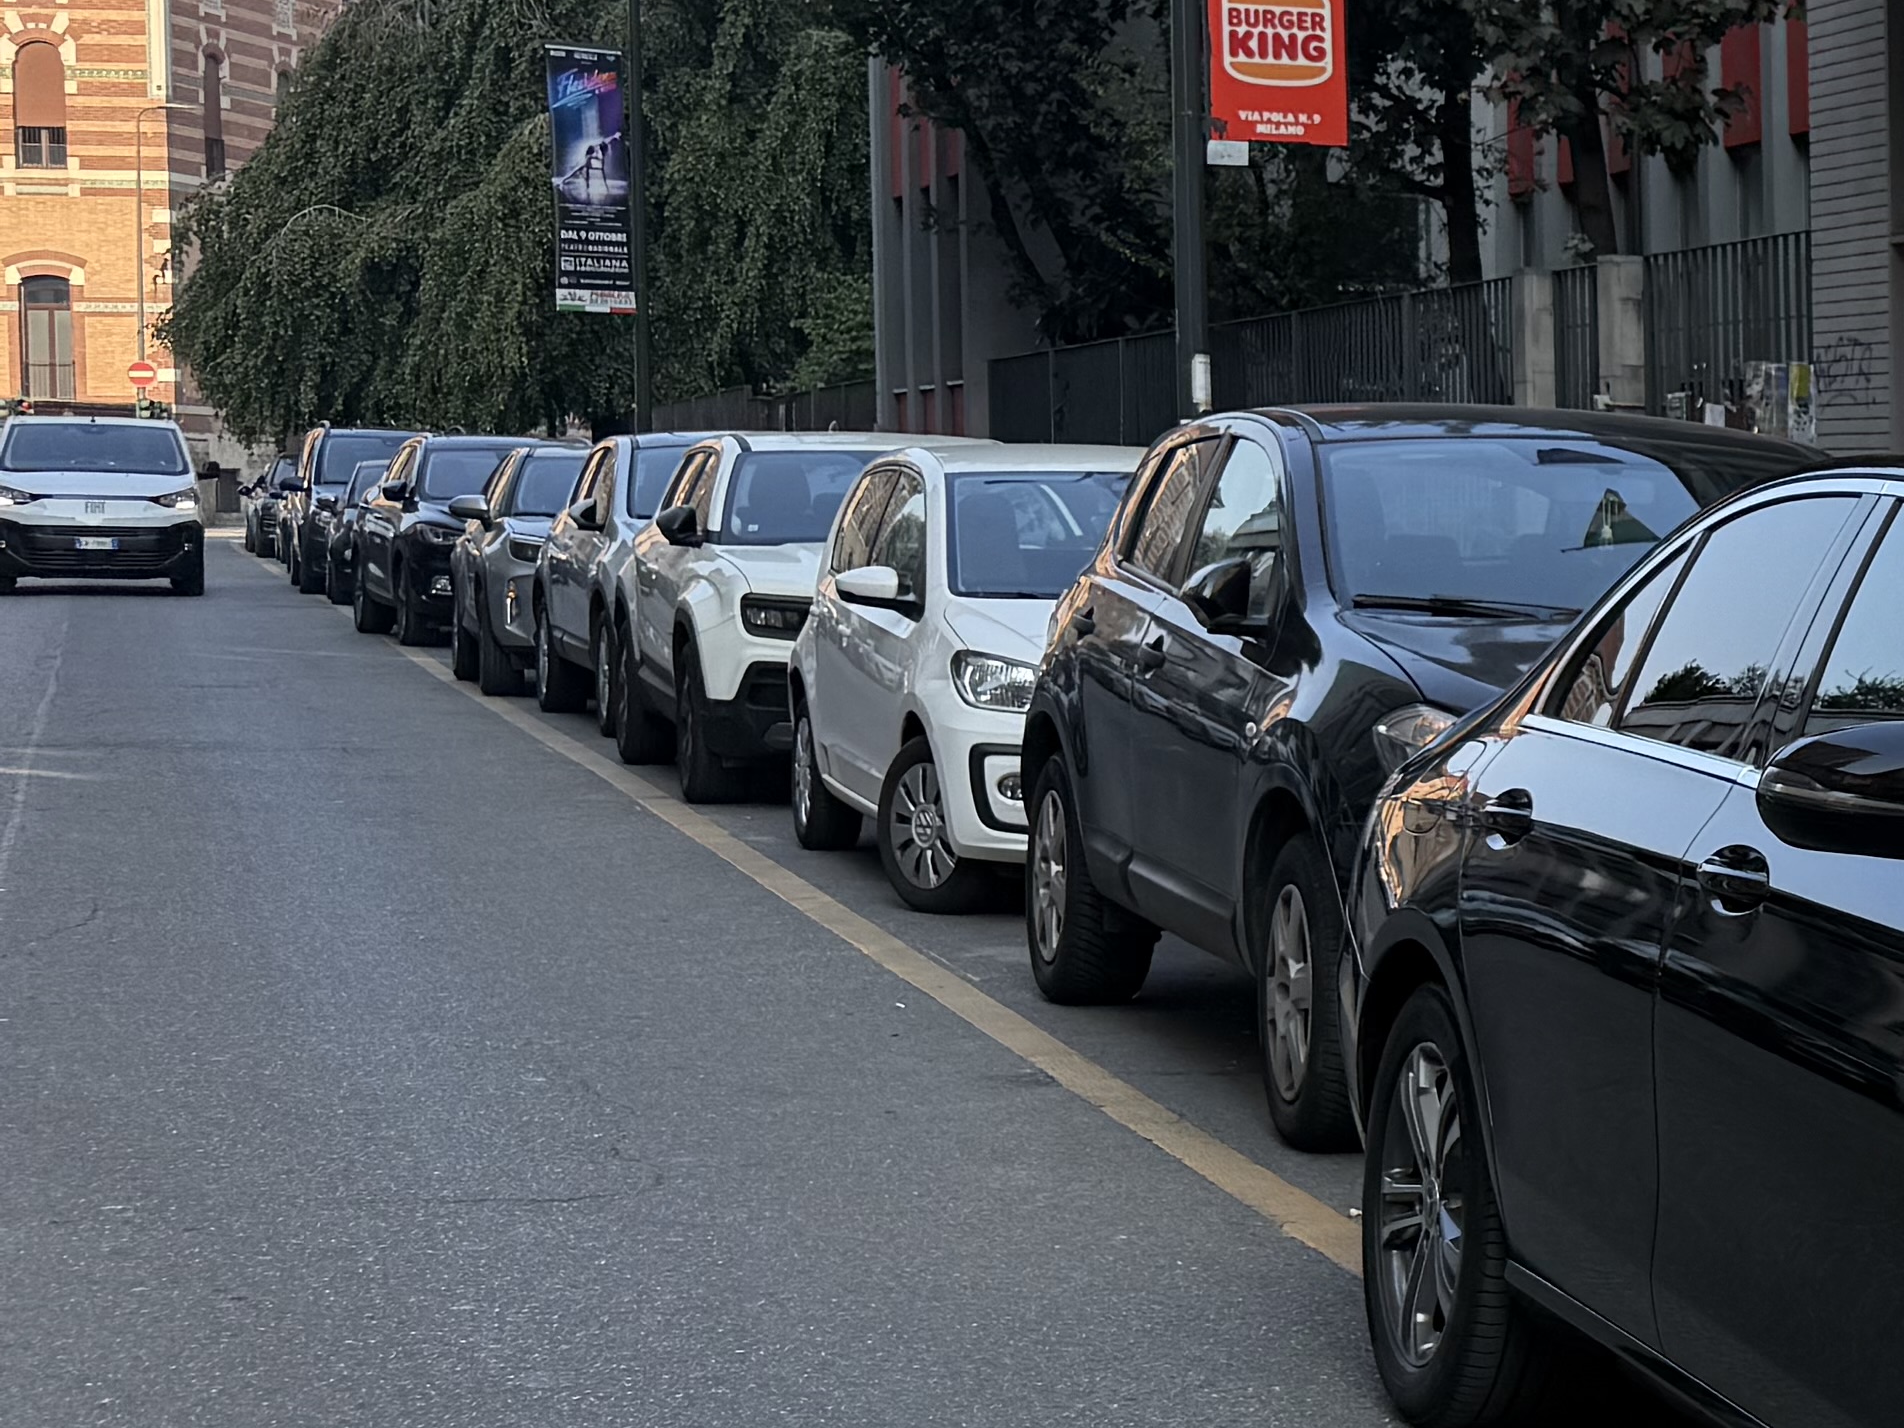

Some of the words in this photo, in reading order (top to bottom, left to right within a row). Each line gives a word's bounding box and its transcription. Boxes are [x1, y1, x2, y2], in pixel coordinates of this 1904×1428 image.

[1228, 7, 1326, 33] BURGER
[1228, 29, 1327, 63] KING
[1238, 110, 1261, 121] VIA
[1263, 111, 1295, 123] POLA
[1313, 114, 1322, 124] 9
[1256, 123, 1305, 136] MILANO
[560, 229, 579, 240] DAL
[588, 231, 627, 243] OTTOBRE
